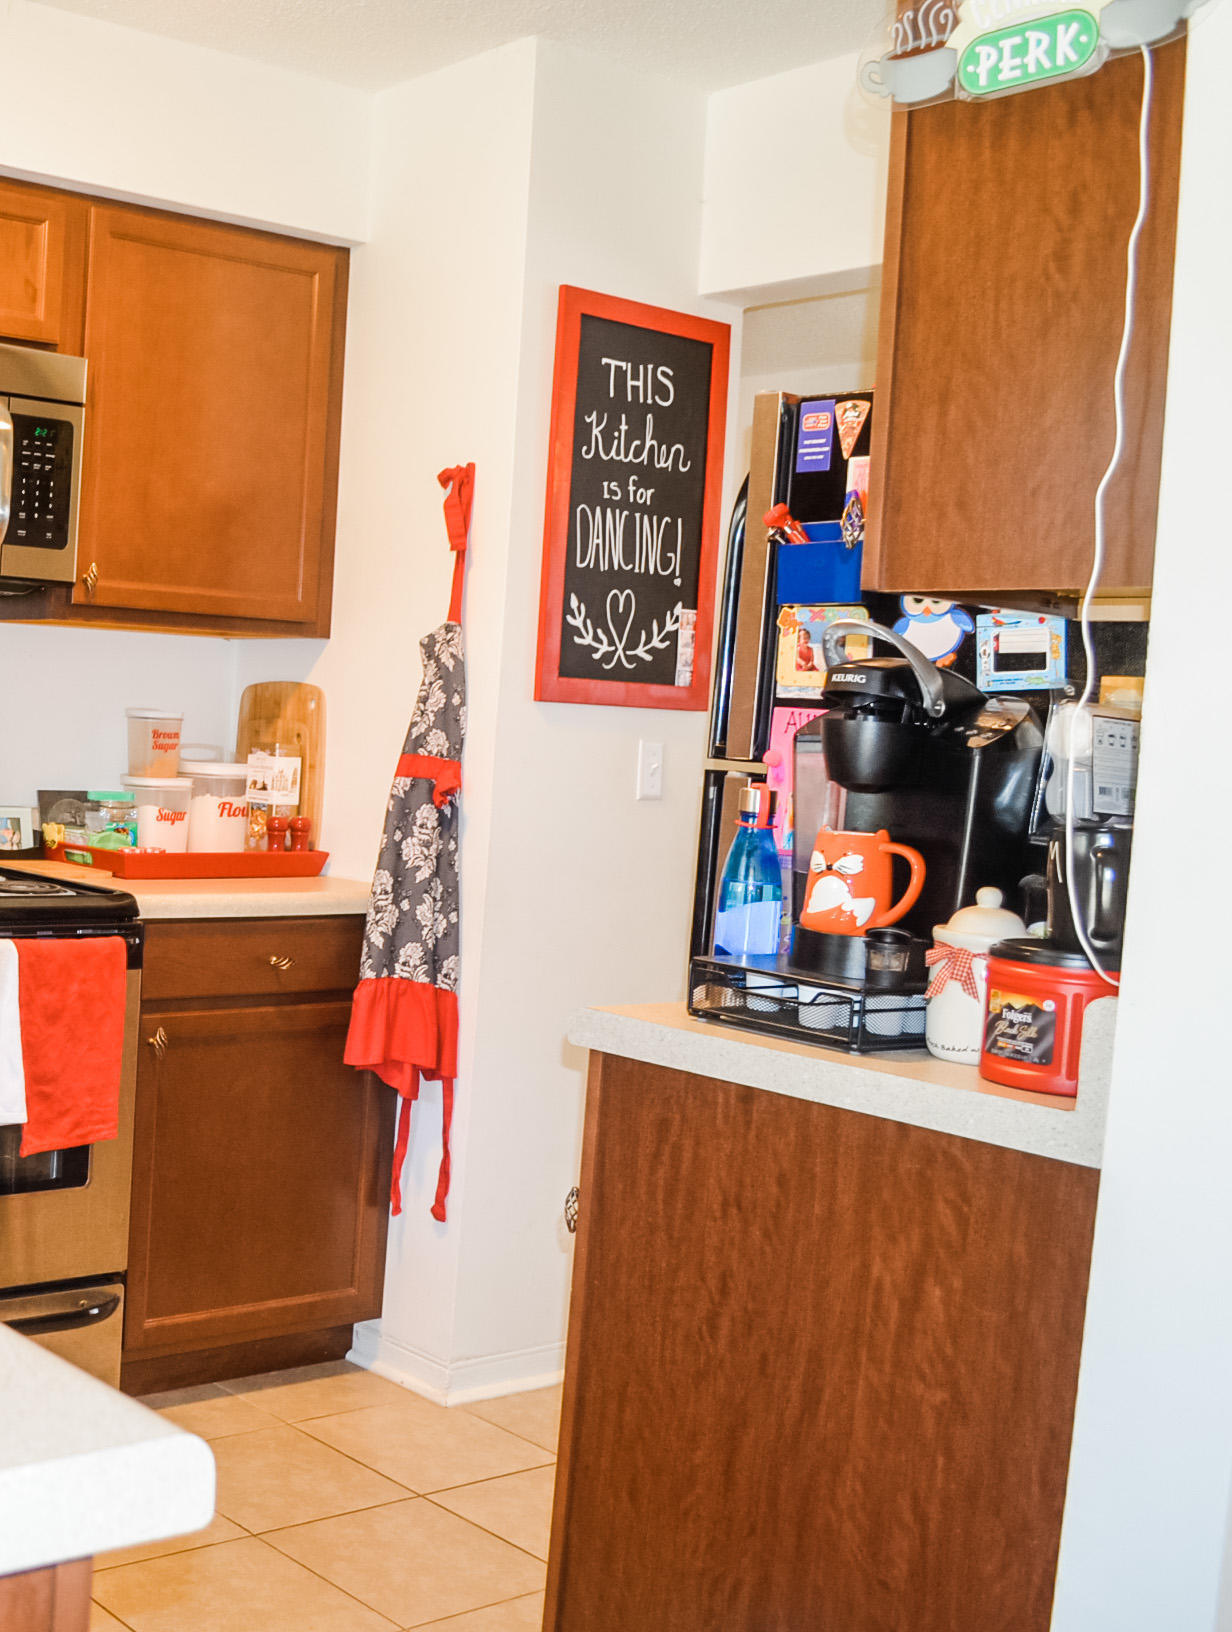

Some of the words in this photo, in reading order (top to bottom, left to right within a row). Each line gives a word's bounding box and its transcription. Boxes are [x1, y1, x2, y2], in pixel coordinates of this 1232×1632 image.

[975, 22, 1079, 87] PERK
[601, 357, 675, 407] THIS
[582, 410, 691, 473] Kitchen
[627, 475, 656, 505] for
[576, 504, 683, 587] DANCING!
[831, 673, 867, 684] KEURIG
[152, 729, 180, 739] Brown
[152, 740, 179, 752] Sugar
[156, 807, 187, 826] Sugar
[217, 801, 249, 818] Flou
[1002, 1007, 1033, 1024] Folgers
